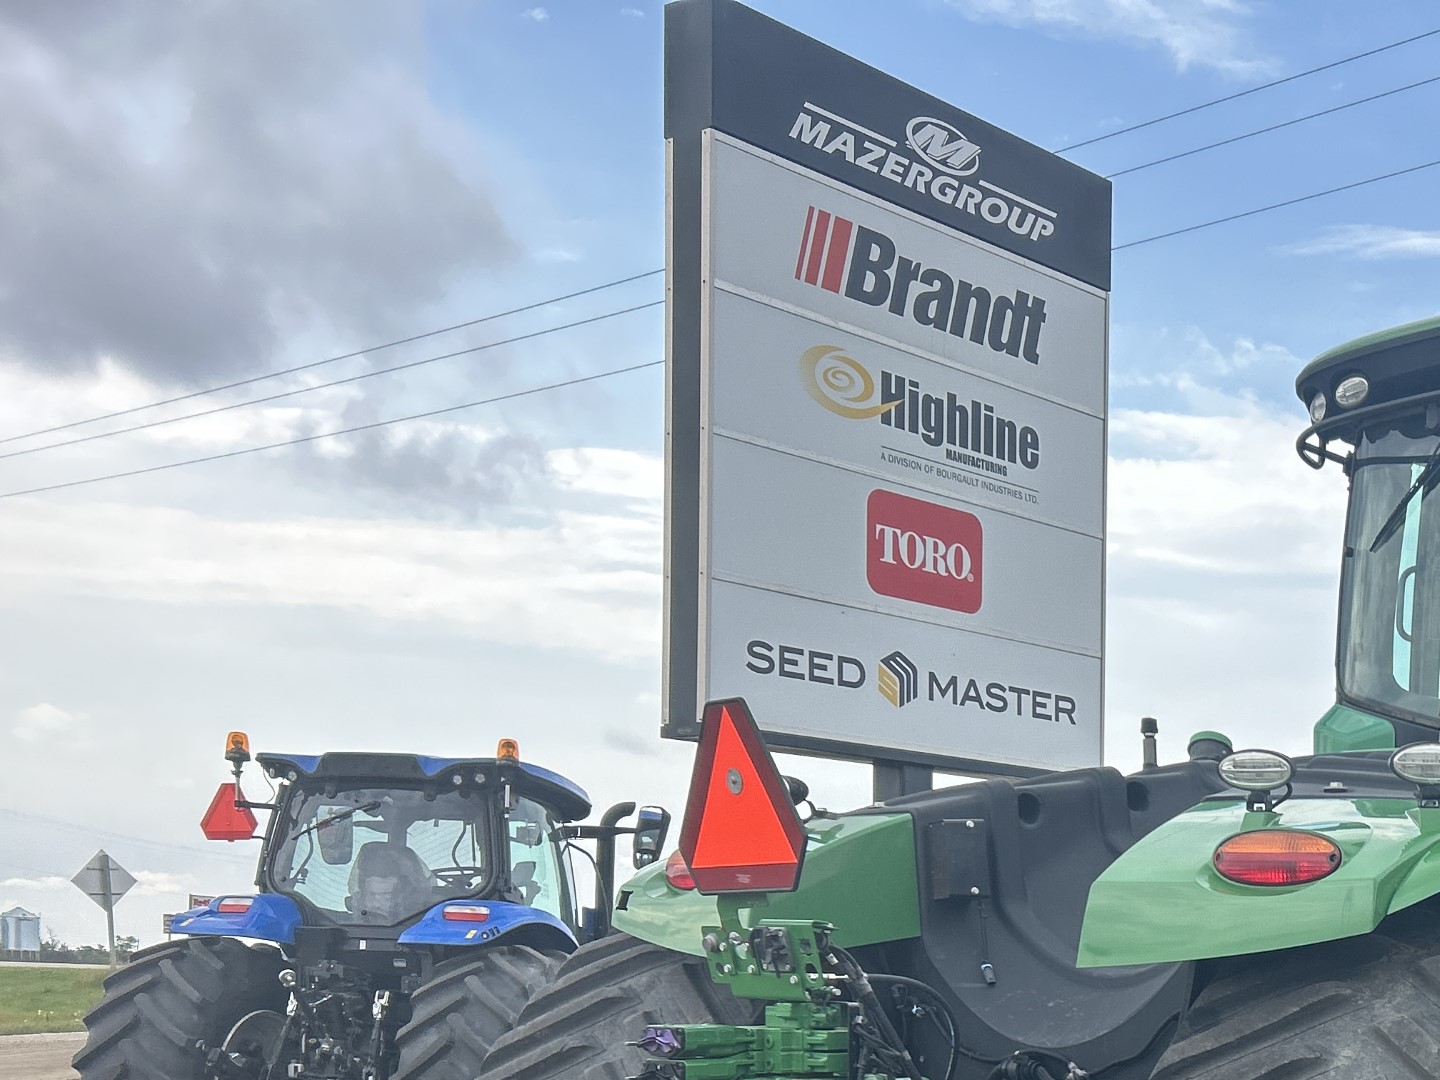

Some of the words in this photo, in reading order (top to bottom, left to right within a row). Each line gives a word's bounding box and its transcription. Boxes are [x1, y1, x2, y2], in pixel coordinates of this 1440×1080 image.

[788, 111, 1056, 242] MAZERGROUP
[844, 224, 1047, 366] Brandt
[880, 370, 1040, 470] Highline
[945, 448, 1008, 477] MANUFACTURING
[880, 452, 887, 461] A
[888, 454, 922, 472] DIVISION
[924, 464, 935, 474] OF
[936, 467, 980, 487] BOURGAULT
[981, 480, 1023, 500] INDUSTRIES
[745, 639, 867, 690] SEED
[927, 671, 1077, 726] MASTER
